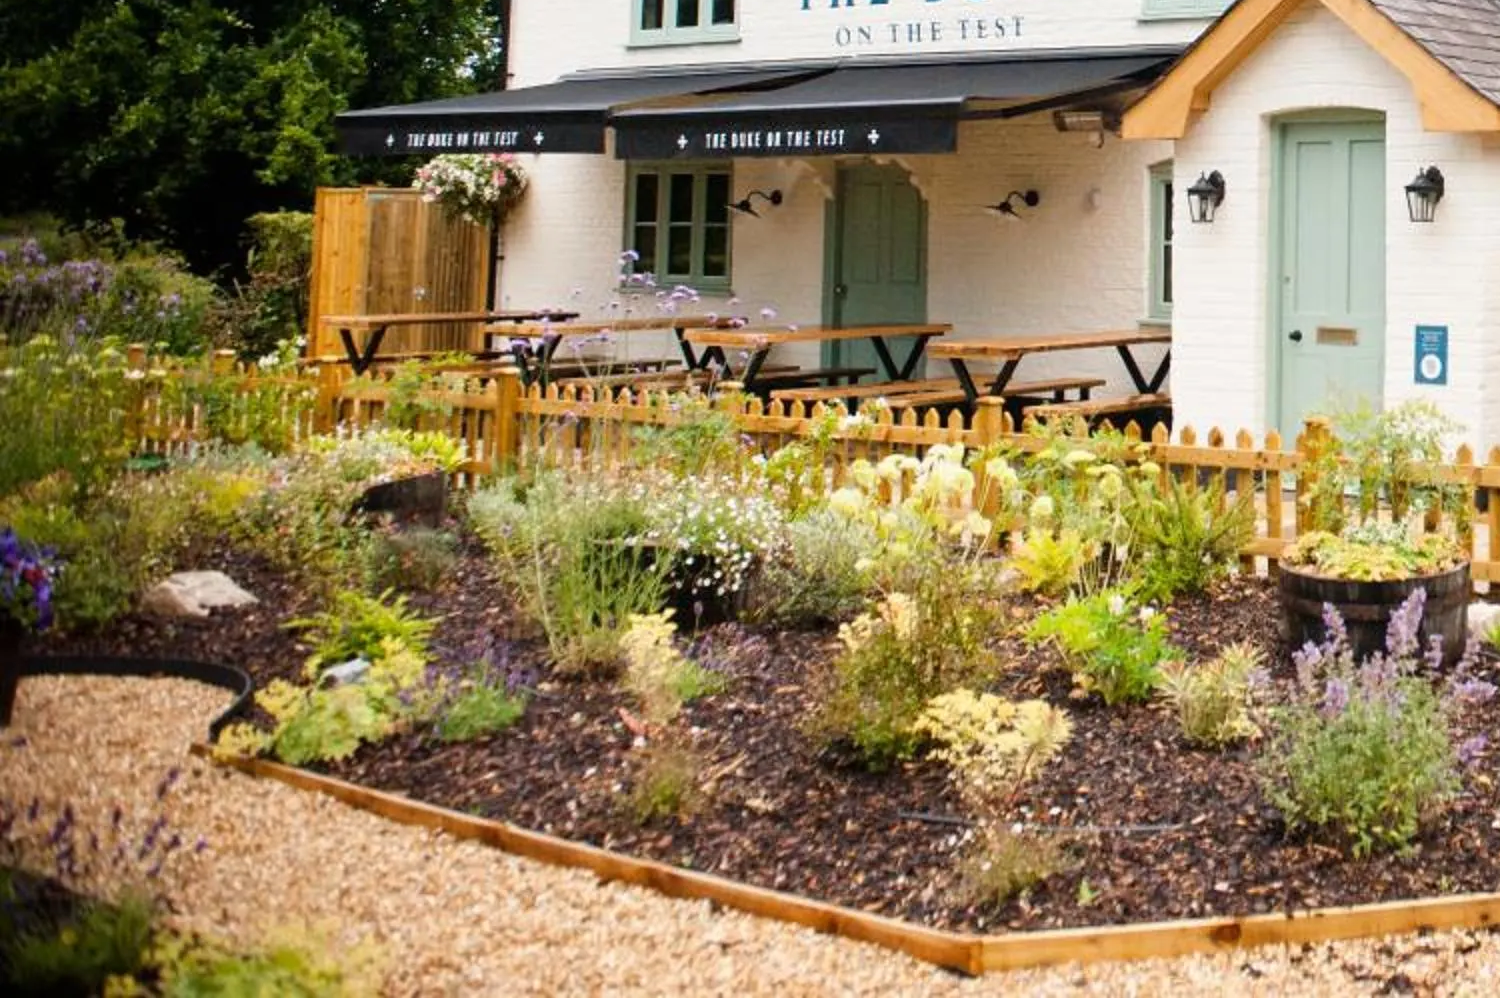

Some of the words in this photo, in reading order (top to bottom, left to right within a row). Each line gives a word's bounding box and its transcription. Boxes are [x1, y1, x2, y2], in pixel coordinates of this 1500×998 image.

[835, 24, 873, 47] ON
[888, 20, 944, 44] THE
[958, 15, 1026, 41] TEST
[705, 133, 728, 149] THE
[731, 131, 761, 148] DUKE
[787, 130, 811, 147] THE
[817, 129, 846, 146] TEST
